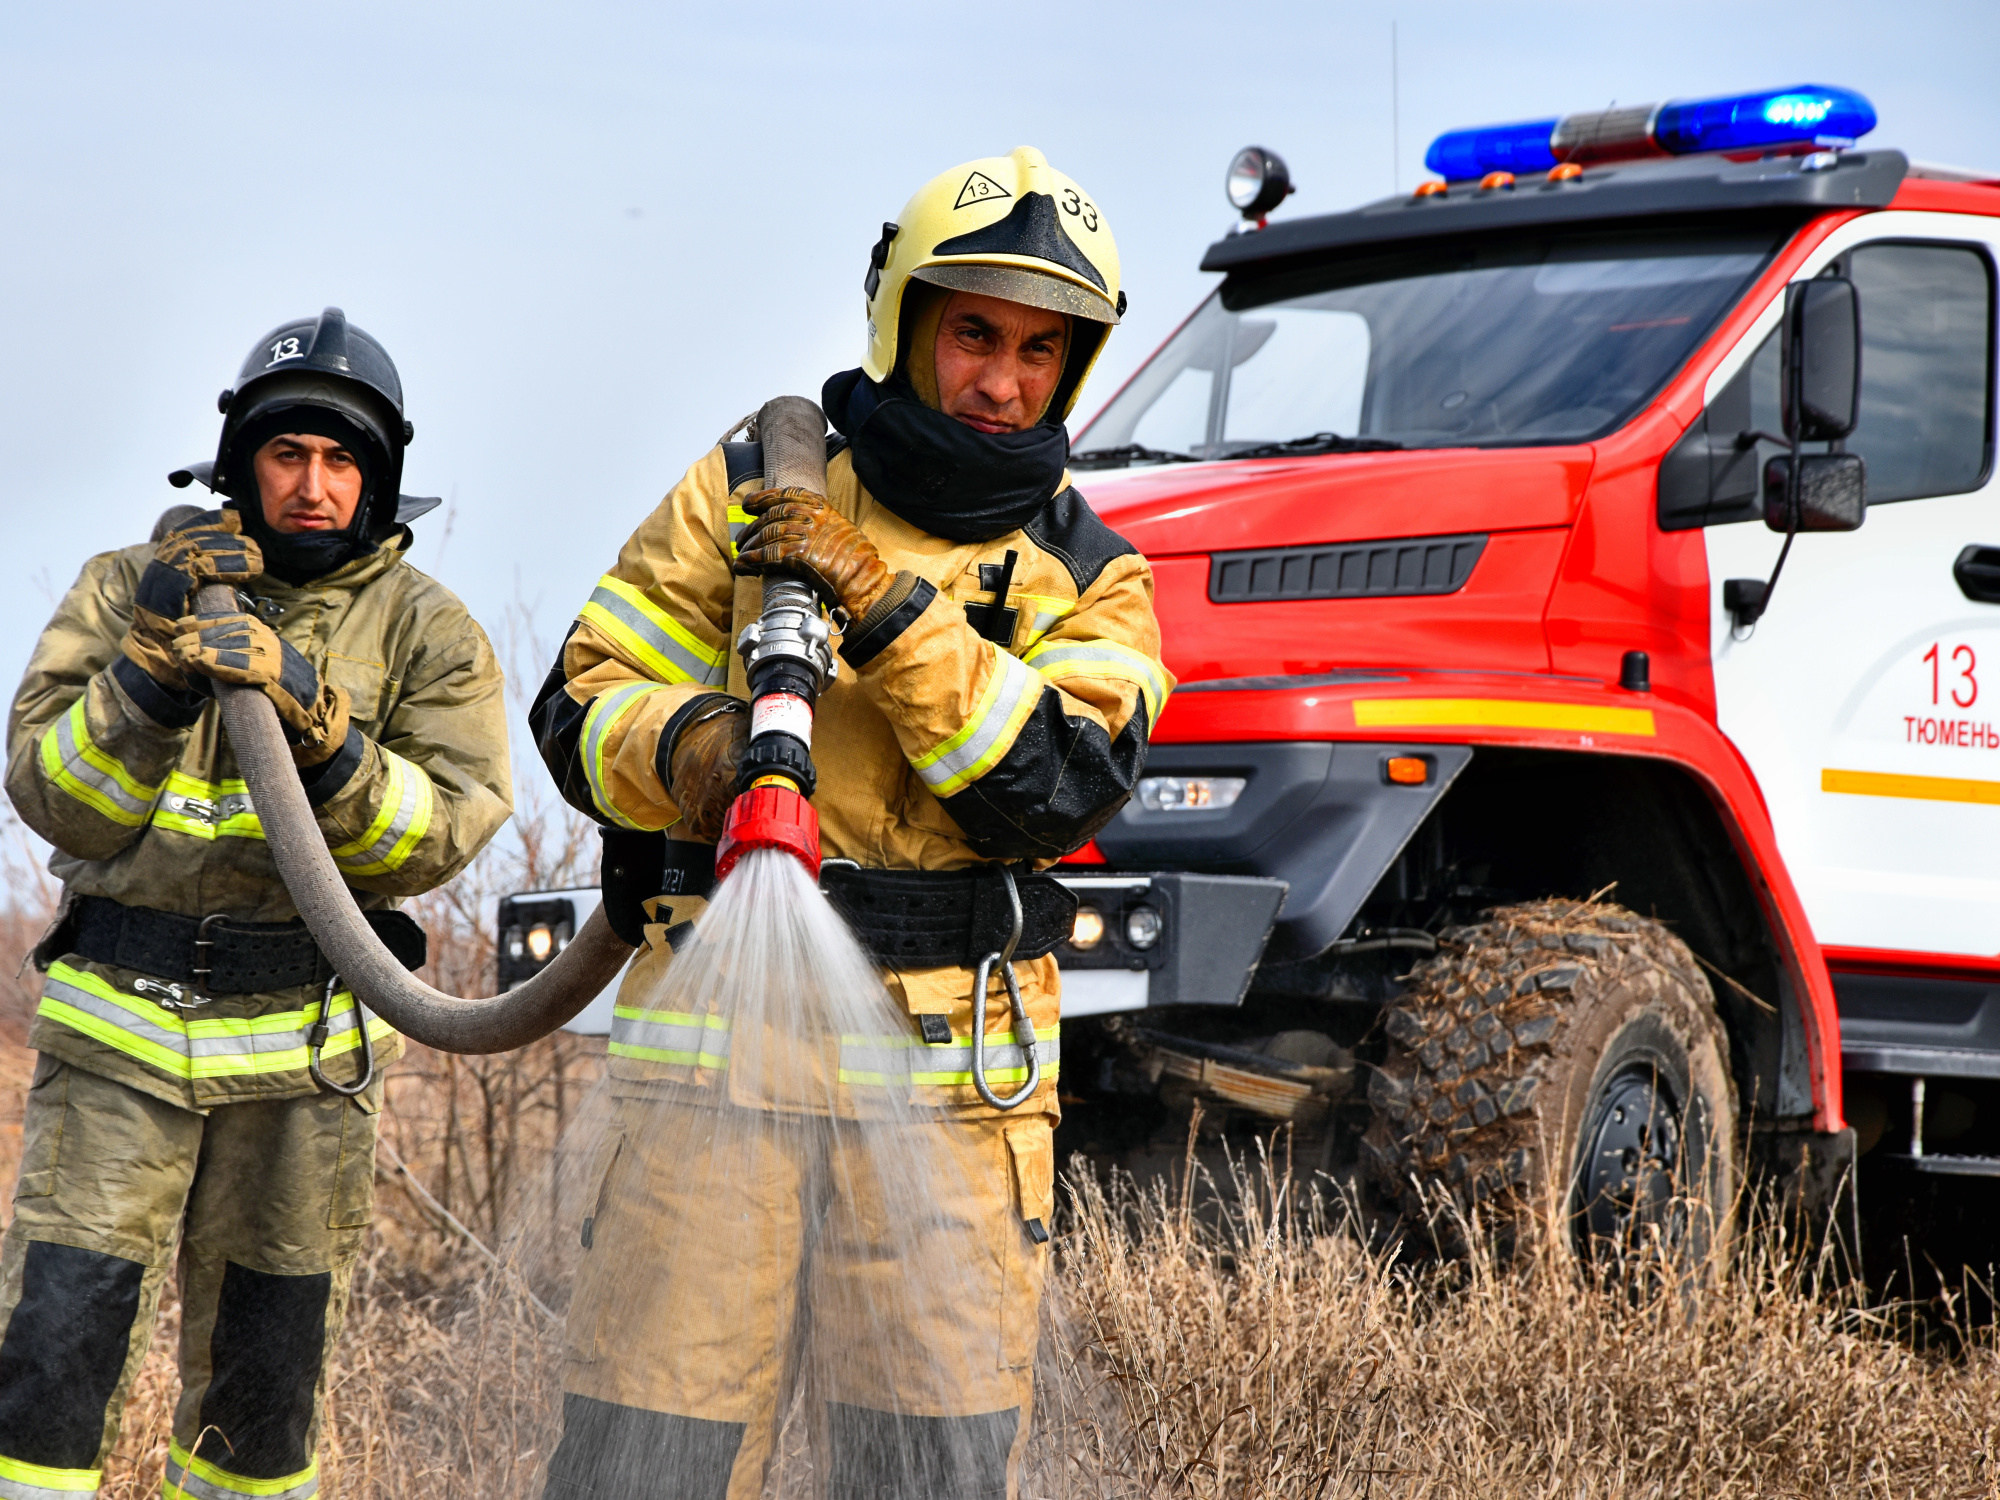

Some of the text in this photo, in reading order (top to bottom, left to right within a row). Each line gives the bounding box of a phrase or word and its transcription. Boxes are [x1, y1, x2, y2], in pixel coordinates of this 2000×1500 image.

[967, 182, 990, 198] 13
[1062, 188, 1098, 233] 33
[270, 337, 300, 361] 13
[1923, 641, 1978, 709] 13
[1903, 715, 2000, 750] ТЮМЕНЬ
